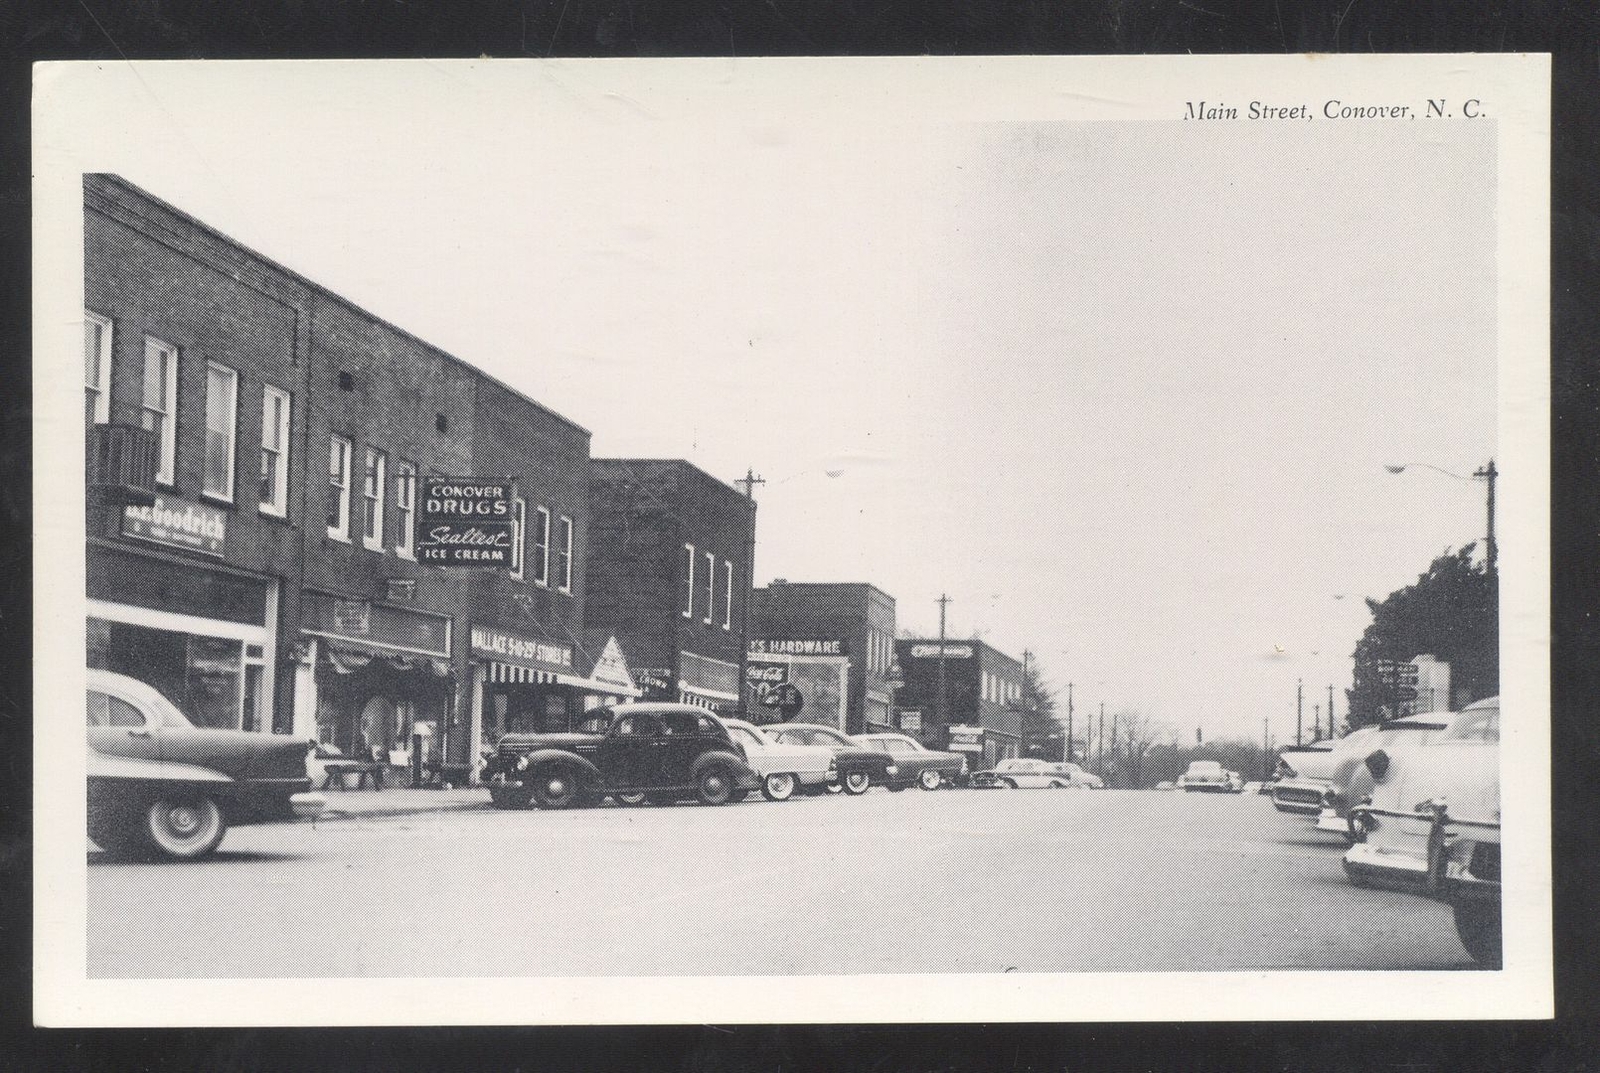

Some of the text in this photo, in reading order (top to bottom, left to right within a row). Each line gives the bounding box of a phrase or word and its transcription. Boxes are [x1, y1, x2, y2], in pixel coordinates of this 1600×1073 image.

[431, 485, 503, 498] CONOVER
[426, 499, 507, 515] DRUGS
[419, 525, 510, 546] Sealtest
[425, 549, 504, 560] ICE CREAM
[471, 628, 507, 654] WALLACE
[769, 640, 841, 654] HARDWARE
